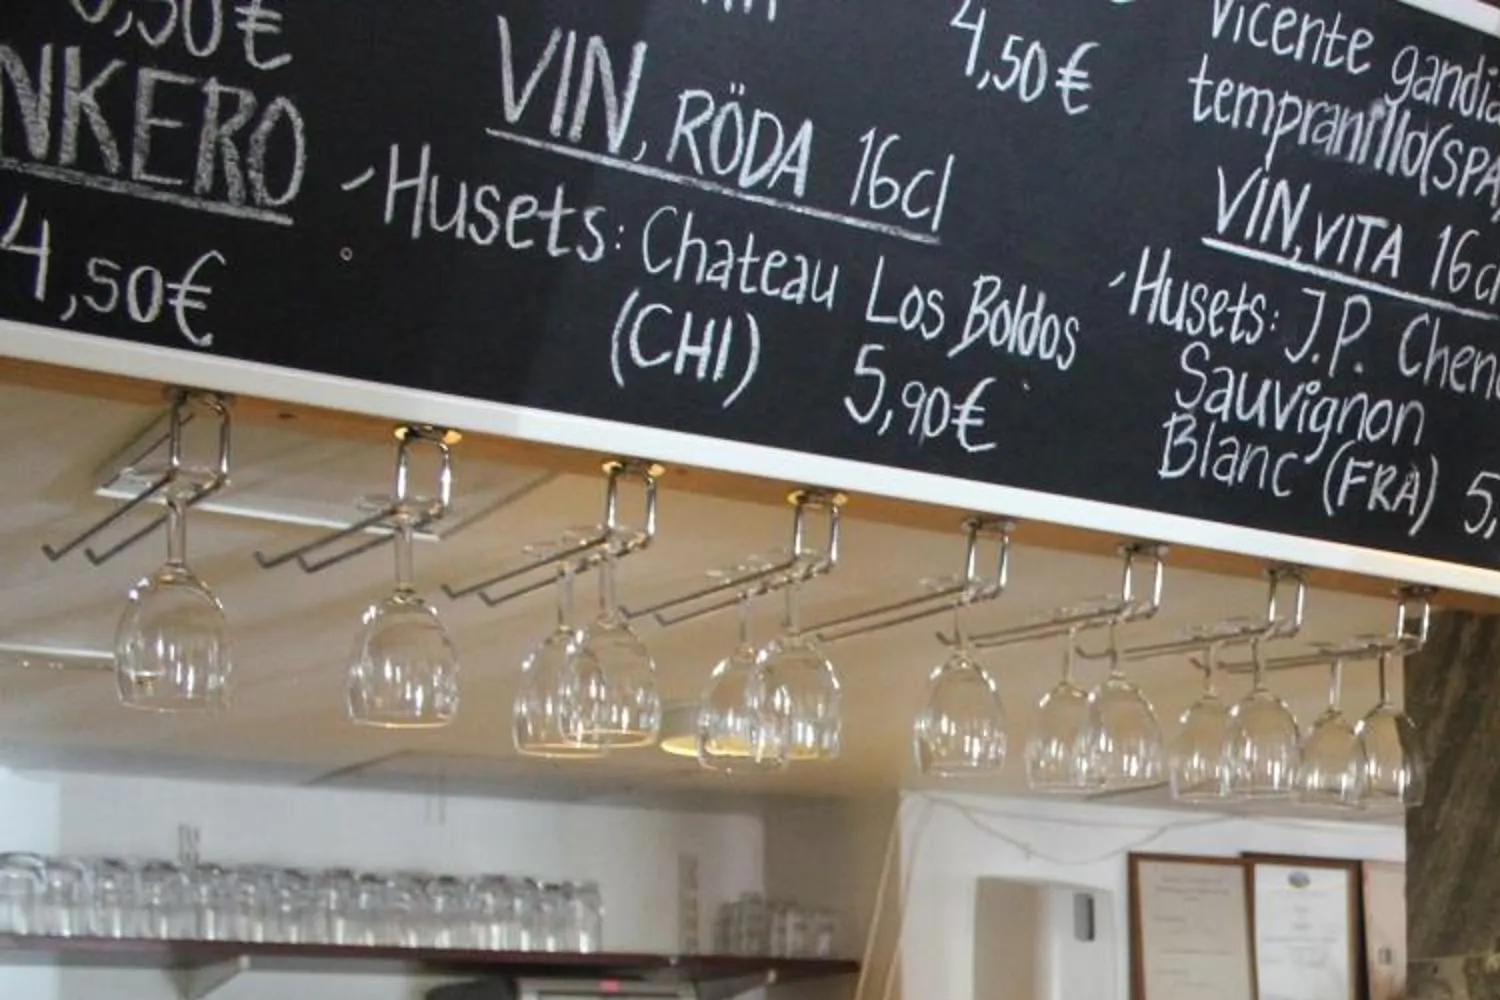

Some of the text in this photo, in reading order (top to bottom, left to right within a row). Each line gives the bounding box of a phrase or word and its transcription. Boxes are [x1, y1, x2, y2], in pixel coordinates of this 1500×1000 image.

[1211, 0, 1375, 76] Vicente
[666, 83, 813, 198] RÖDA
[849, 126, 955, 232] 16cl
[642, 205, 838, 311] Chateau
[865, 255, 945, 341] Los
[947, 274, 1080, 372] Boldos
[1314, 214, 1403, 280] VITA
[611, 289, 997, 454] (CHI) 5,90€
[1175, 341, 1426, 465] Sauvignon
[1158, 411, 1300, 498] Blanc
[1322, 441, 1440, 537] (FRA)
